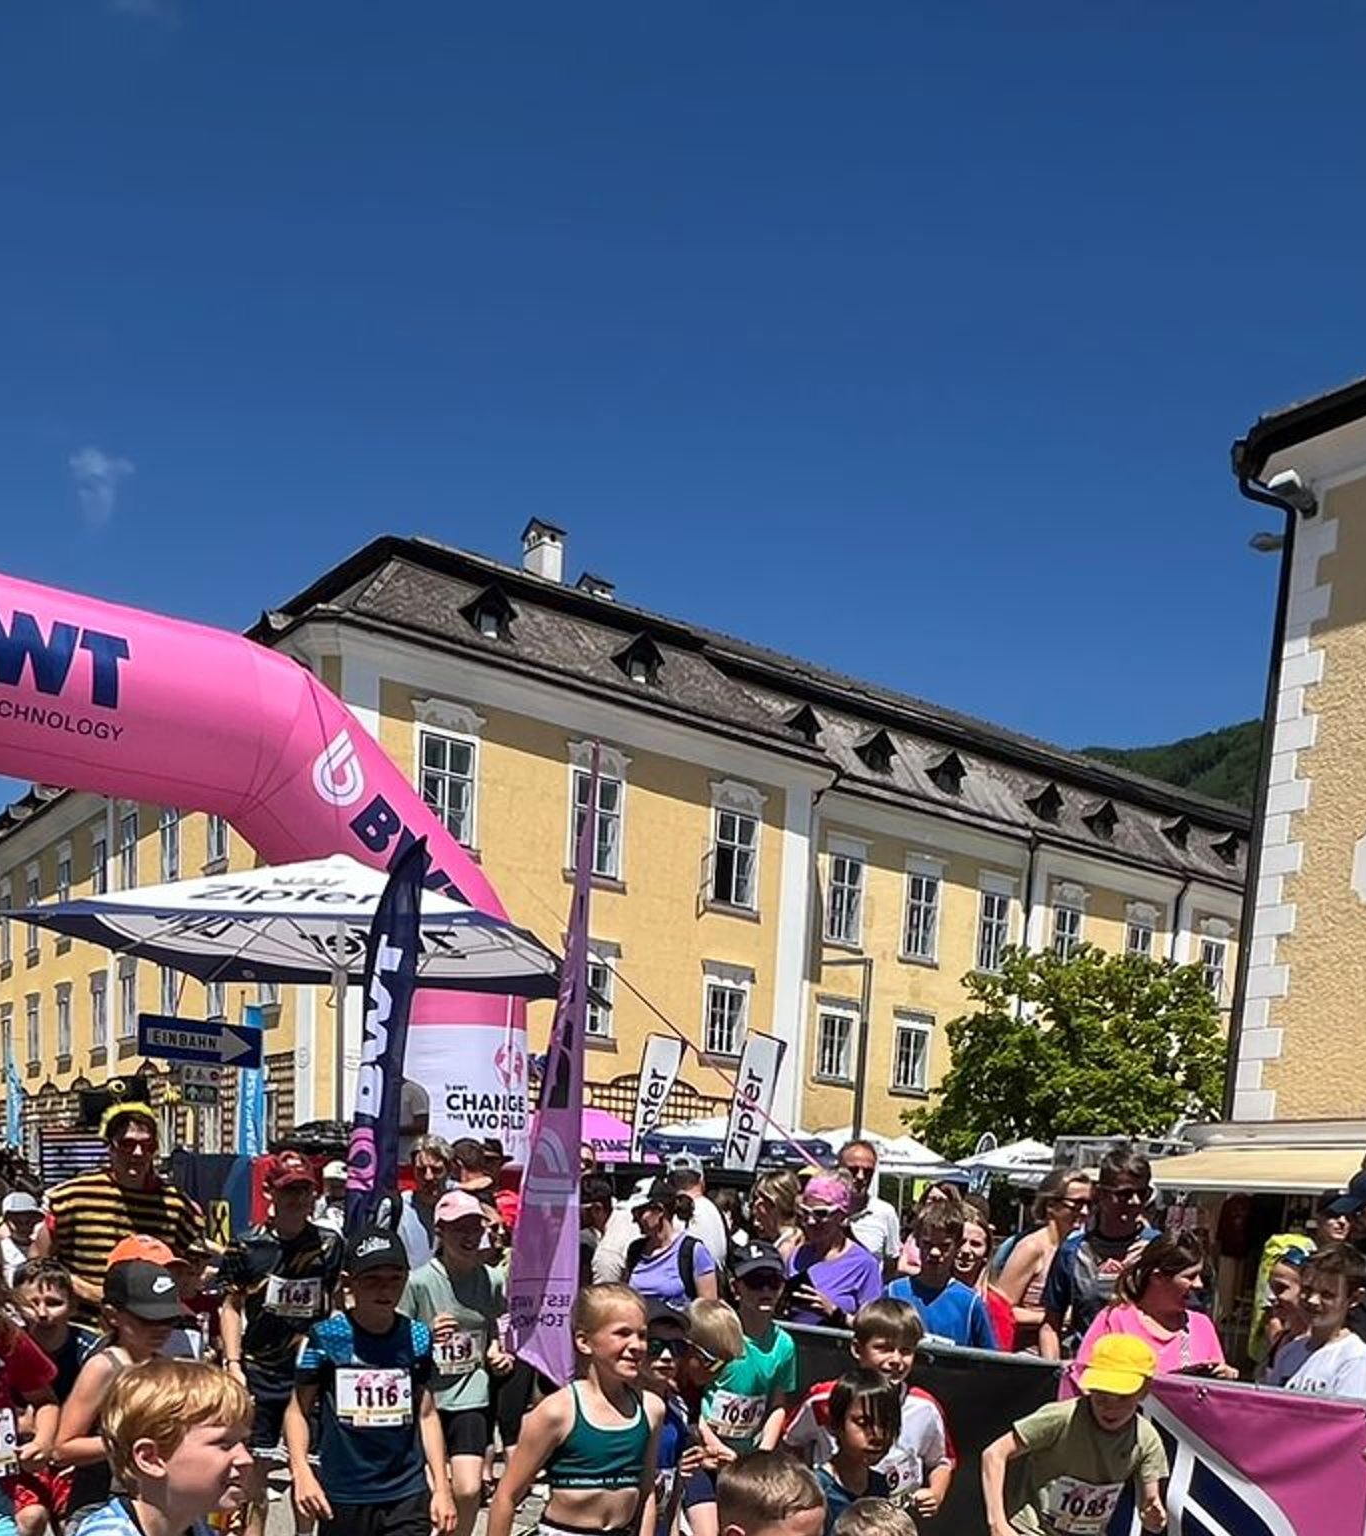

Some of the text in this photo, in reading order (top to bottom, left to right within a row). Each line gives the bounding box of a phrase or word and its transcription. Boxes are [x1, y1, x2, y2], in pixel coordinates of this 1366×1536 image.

[355, 934, 403, 1118] BWT
[152, 1030, 218, 1050] EINBAHN
[446, 1093, 525, 1113] CHANGE
[635, 1068, 668, 1152] ipfer
[467, 1113, 525, 1131] WORLD
[728, 1068, 763, 1163] Zipfer
[354, 1385, 398, 1408] 1116
